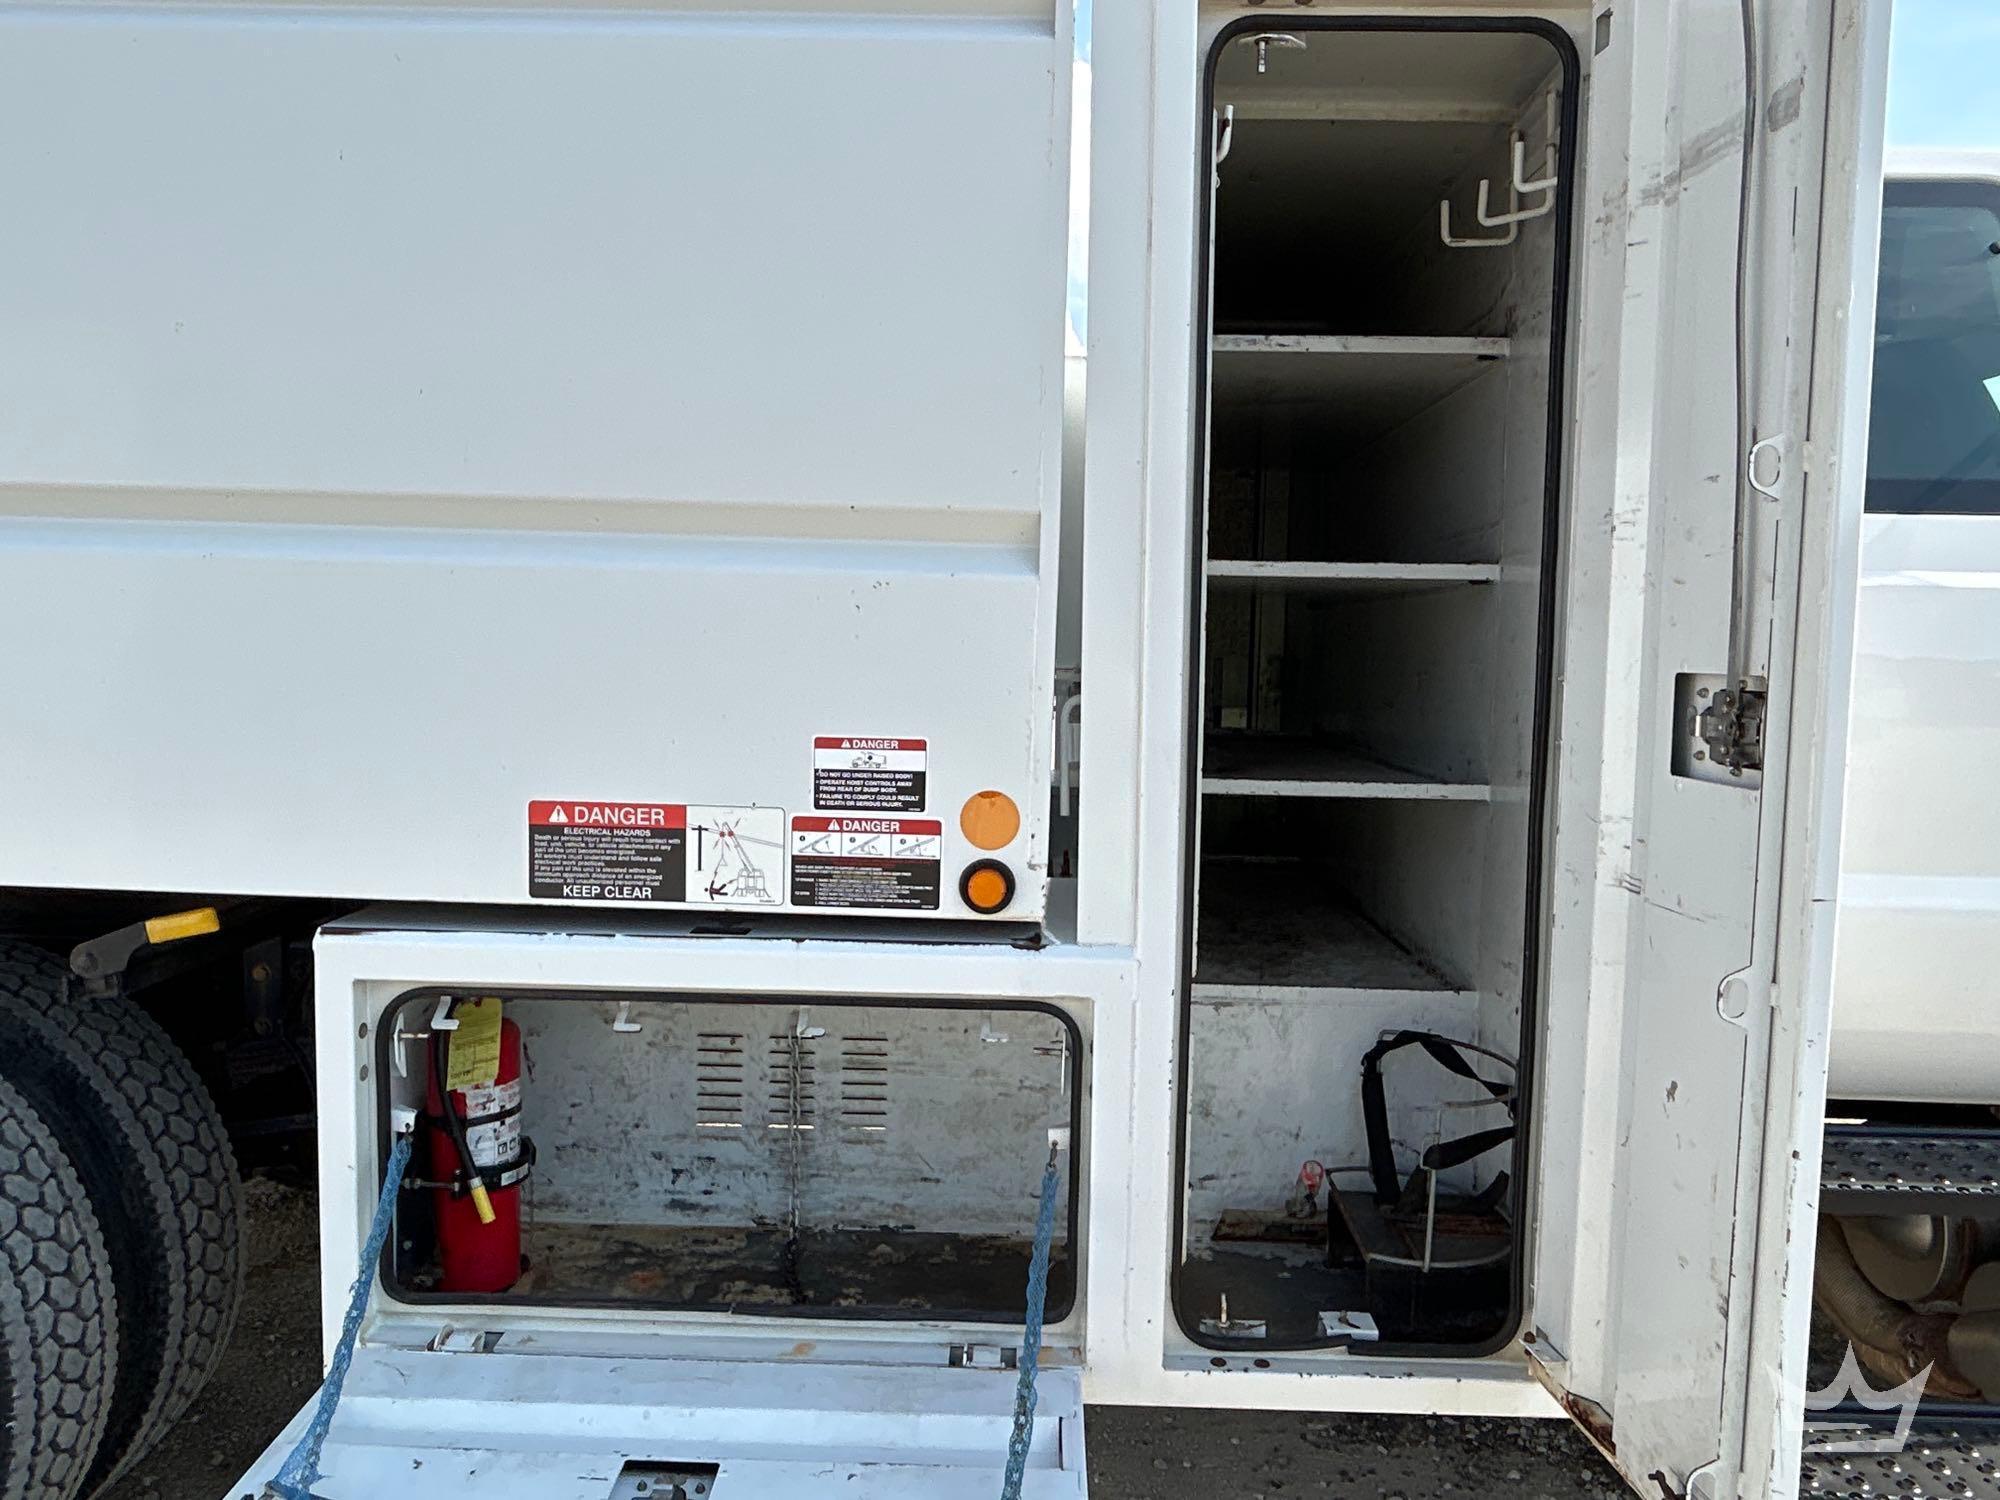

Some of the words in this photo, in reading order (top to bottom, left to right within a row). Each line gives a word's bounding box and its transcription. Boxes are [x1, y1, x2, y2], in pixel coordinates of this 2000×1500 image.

[852, 740, 898, 749] DANGER
[574, 806, 665, 825] DANGER
[564, 827, 612, 836] ELECTRICAL
[613, 829, 651, 837] HAZARDS
[842, 820, 900, 832] DANGER
[563, 885, 600, 897] KEEP
[605, 887, 651, 899] CLEAR
